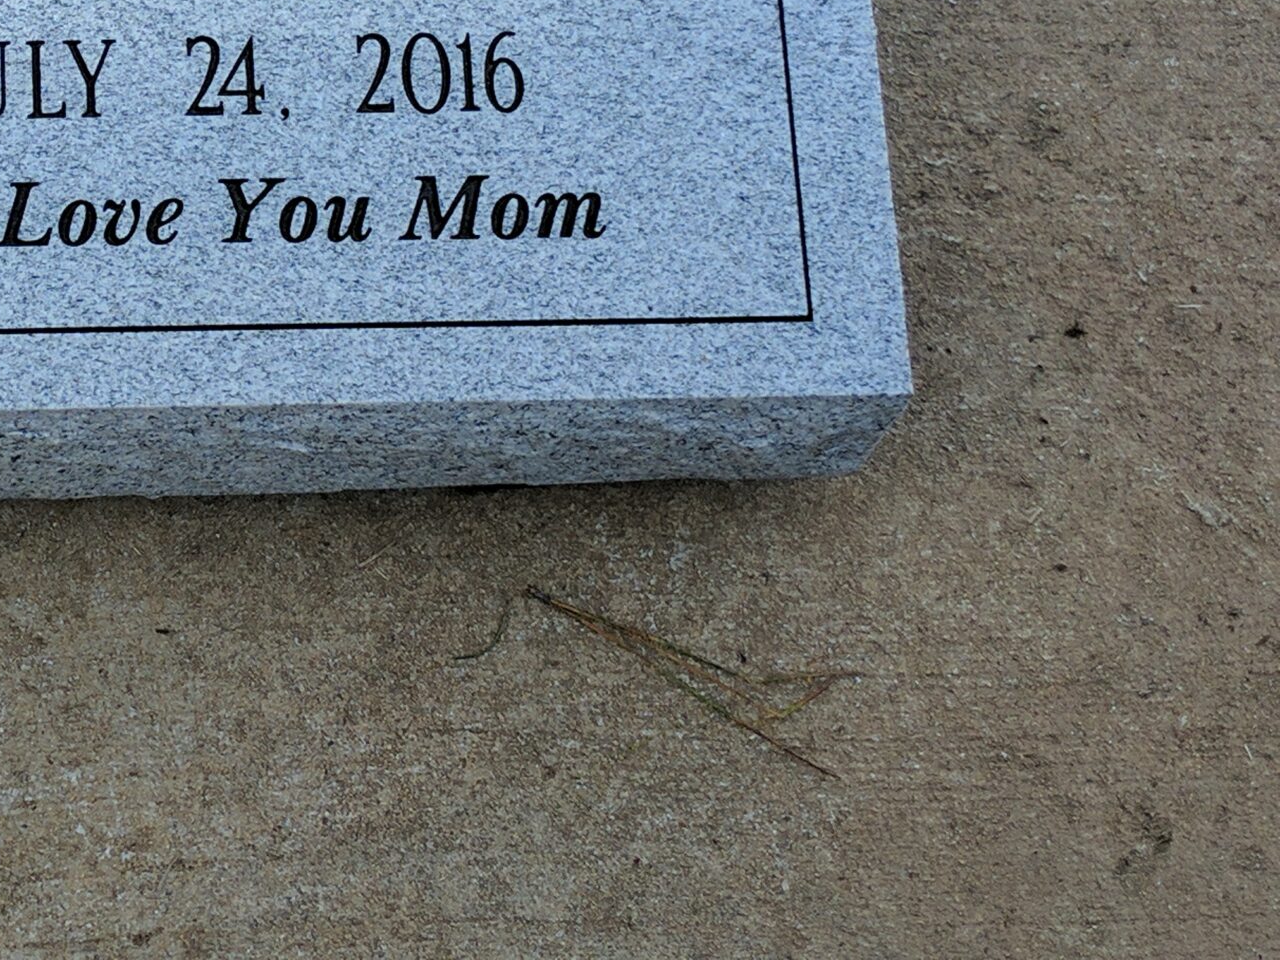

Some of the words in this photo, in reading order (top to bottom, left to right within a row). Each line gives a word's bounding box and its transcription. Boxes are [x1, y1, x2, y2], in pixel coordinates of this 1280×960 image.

[184, 34, 290, 122] 24,
[355, 30, 526, 115] 2016
[217, 176, 373, 244] You
[397, 174, 608, 241] Mom
